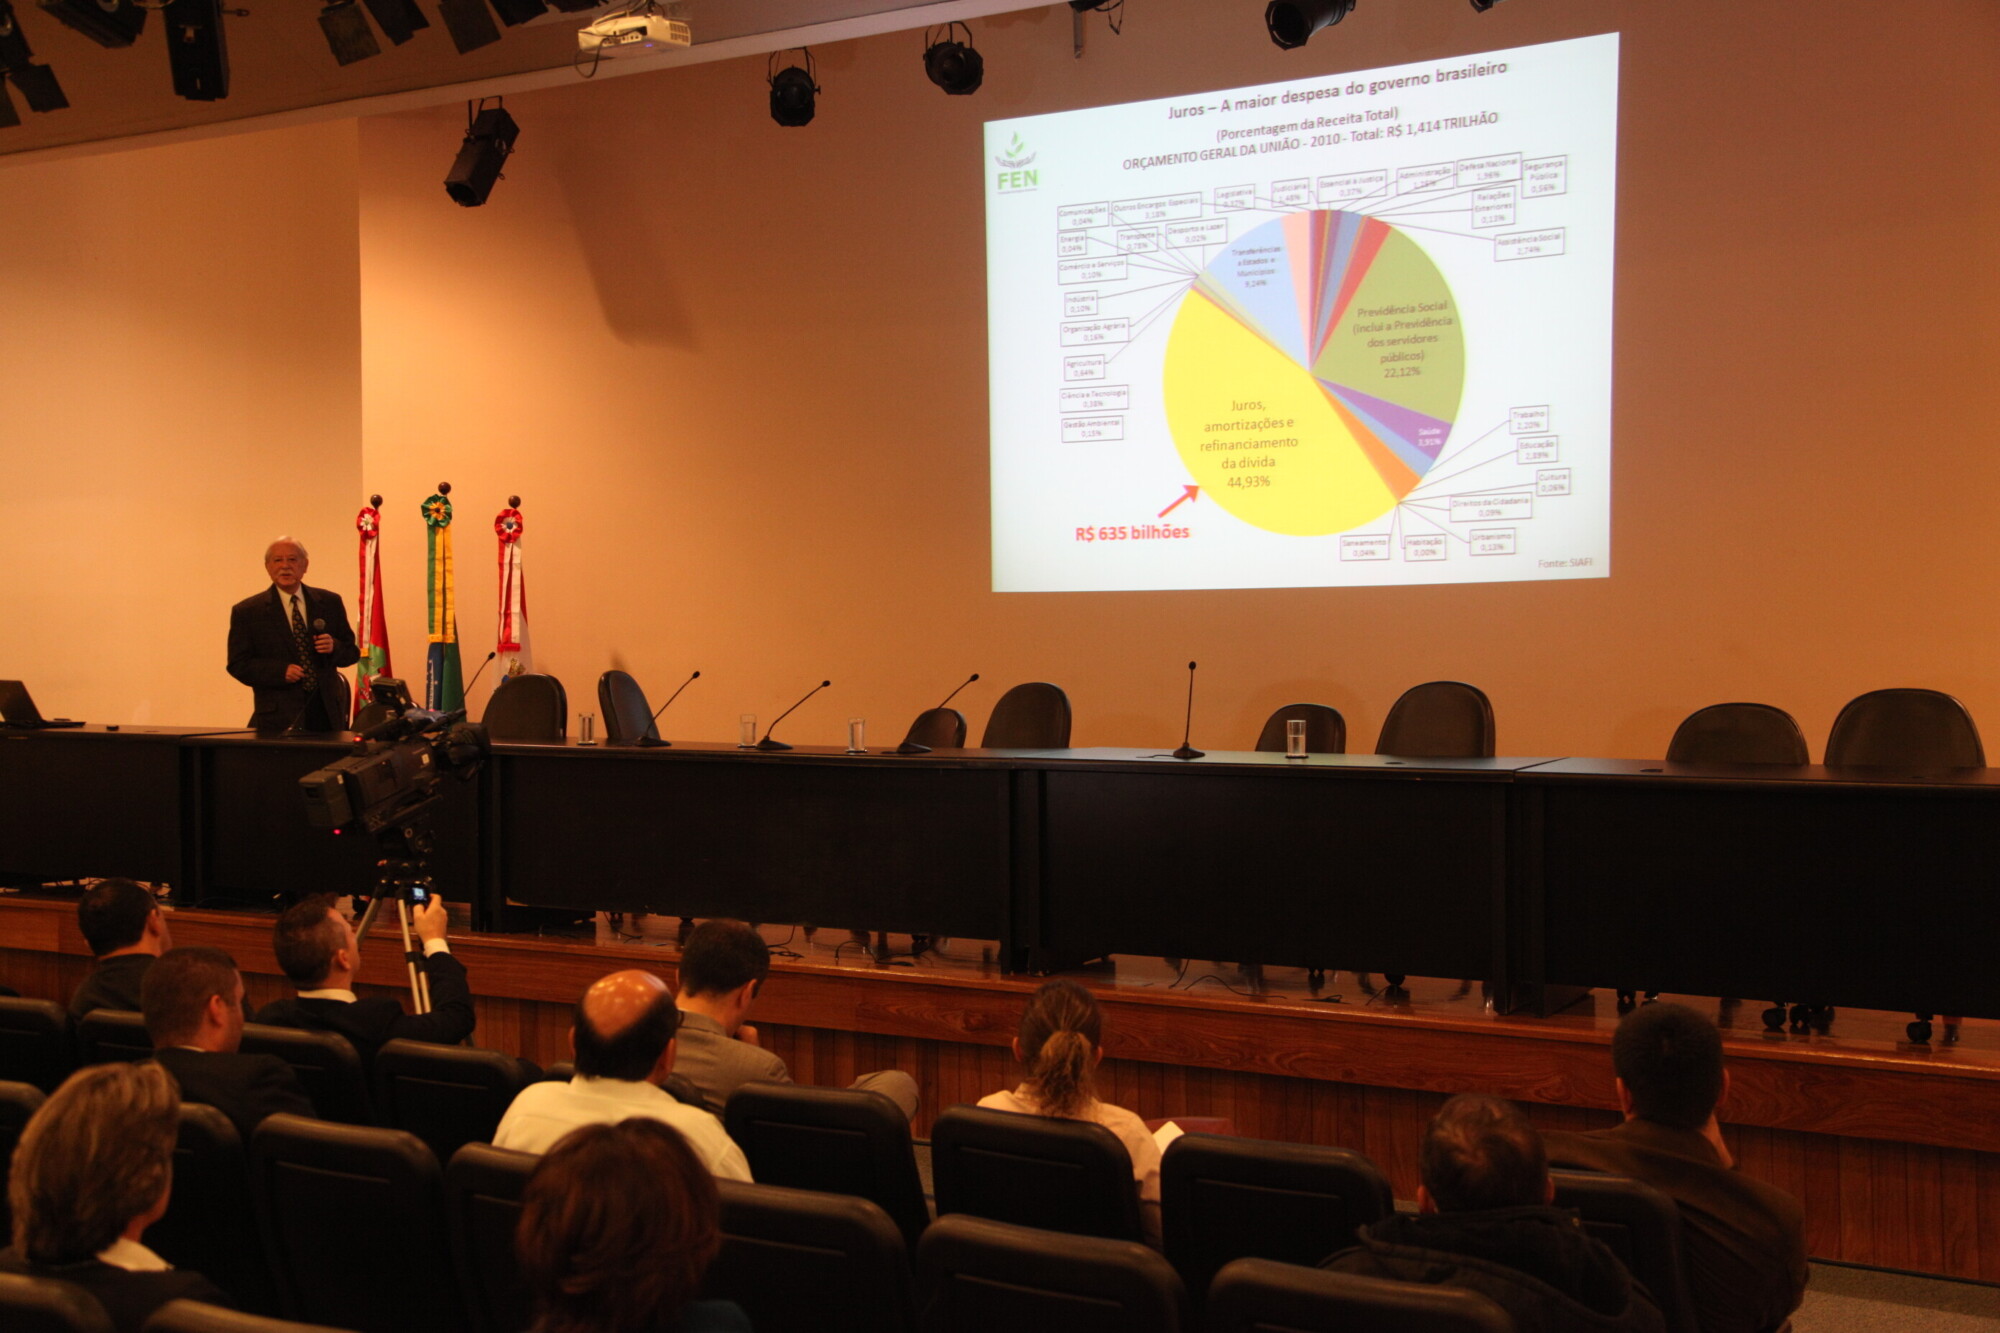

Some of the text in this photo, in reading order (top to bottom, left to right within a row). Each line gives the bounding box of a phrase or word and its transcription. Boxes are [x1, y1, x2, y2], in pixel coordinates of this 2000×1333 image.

[1168, 106, 1204, 119] Juros
[1221, 100, 1231, 112] A
[1235, 94, 1277, 111] maior
[1281, 87, 1340, 104] despesa
[1346, 81, 1364, 95] do
[1369, 74, 1430, 95] governo
[1436, 61, 1508, 83] brasileiro
[1216, 106, 1399, 143] (Porcentagem da Receita Total)
[1123, 151, 1197, 171] ORÇAMENTO
[1200, 145, 1237, 161] GERAL
[1240, 144, 1256, 156] DA
[1260, 137, 1299, 153] UNIÃO
[1311, 133, 1340, 147] 2010
[1350, 128, 1383, 142] Total:
[1387, 124, 1401, 139] R$
[1407, 120, 1440, 136] 1,414
[1444, 111, 1498, 130] TRILHÃO
[1459, 158, 1518, 171] Defesa Nacional
[1524, 160, 1564, 172] Segurança
[998, 169, 1038, 189] FEN
[1399, 167, 1451, 179] Administração
[1530, 172, 1558, 180] Pública
[1320, 178, 1351, 188] Essencial
[1359, 175, 1383, 184] Justiça
[1477, 191, 1510, 201] Relações
[1113, 197, 1198, 213] Outros Encargos Especiais
[1475, 202, 1513, 212] Exteriores
[1059, 206, 1106, 218] Comunicações
[1206, 222, 1224, 231] Lazer
[1539, 233, 1560, 242] Social
[1358, 300, 1447, 318] Previdência Social
[1063, 324, 1101, 335] Organização
[1353, 323, 1383, 335] (inclui
[1394, 317, 1452, 330] Previdência
[1367, 334, 1438, 348] dos servidores
[1380, 351, 1425, 365] públicos)
[1384, 367, 1420, 379] 22,12%
[1061, 391, 1084, 399] Ciência
[1091, 390, 1126, 399] Tecnologia
[1231, 400, 1266, 412] Juros,
[1204, 418, 1294, 433] amortizações e
[1200, 437, 1298, 452] refinanciamento
[1520, 440, 1555, 449] Educação
[1222, 456, 1276, 470] da dívida
[1227, 476, 1270, 490] 44,93%
[1452, 499, 1482, 508] Direitos
[1493, 496, 1529, 506] Cidadania
[1076, 524, 1190, 543] R$ 635 bilhões
[1472, 532, 1512, 542] Urbanismo
[1407, 537, 1443, 547] Habitação
[1538, 557, 1593, 568] Fonte: SIAFI
